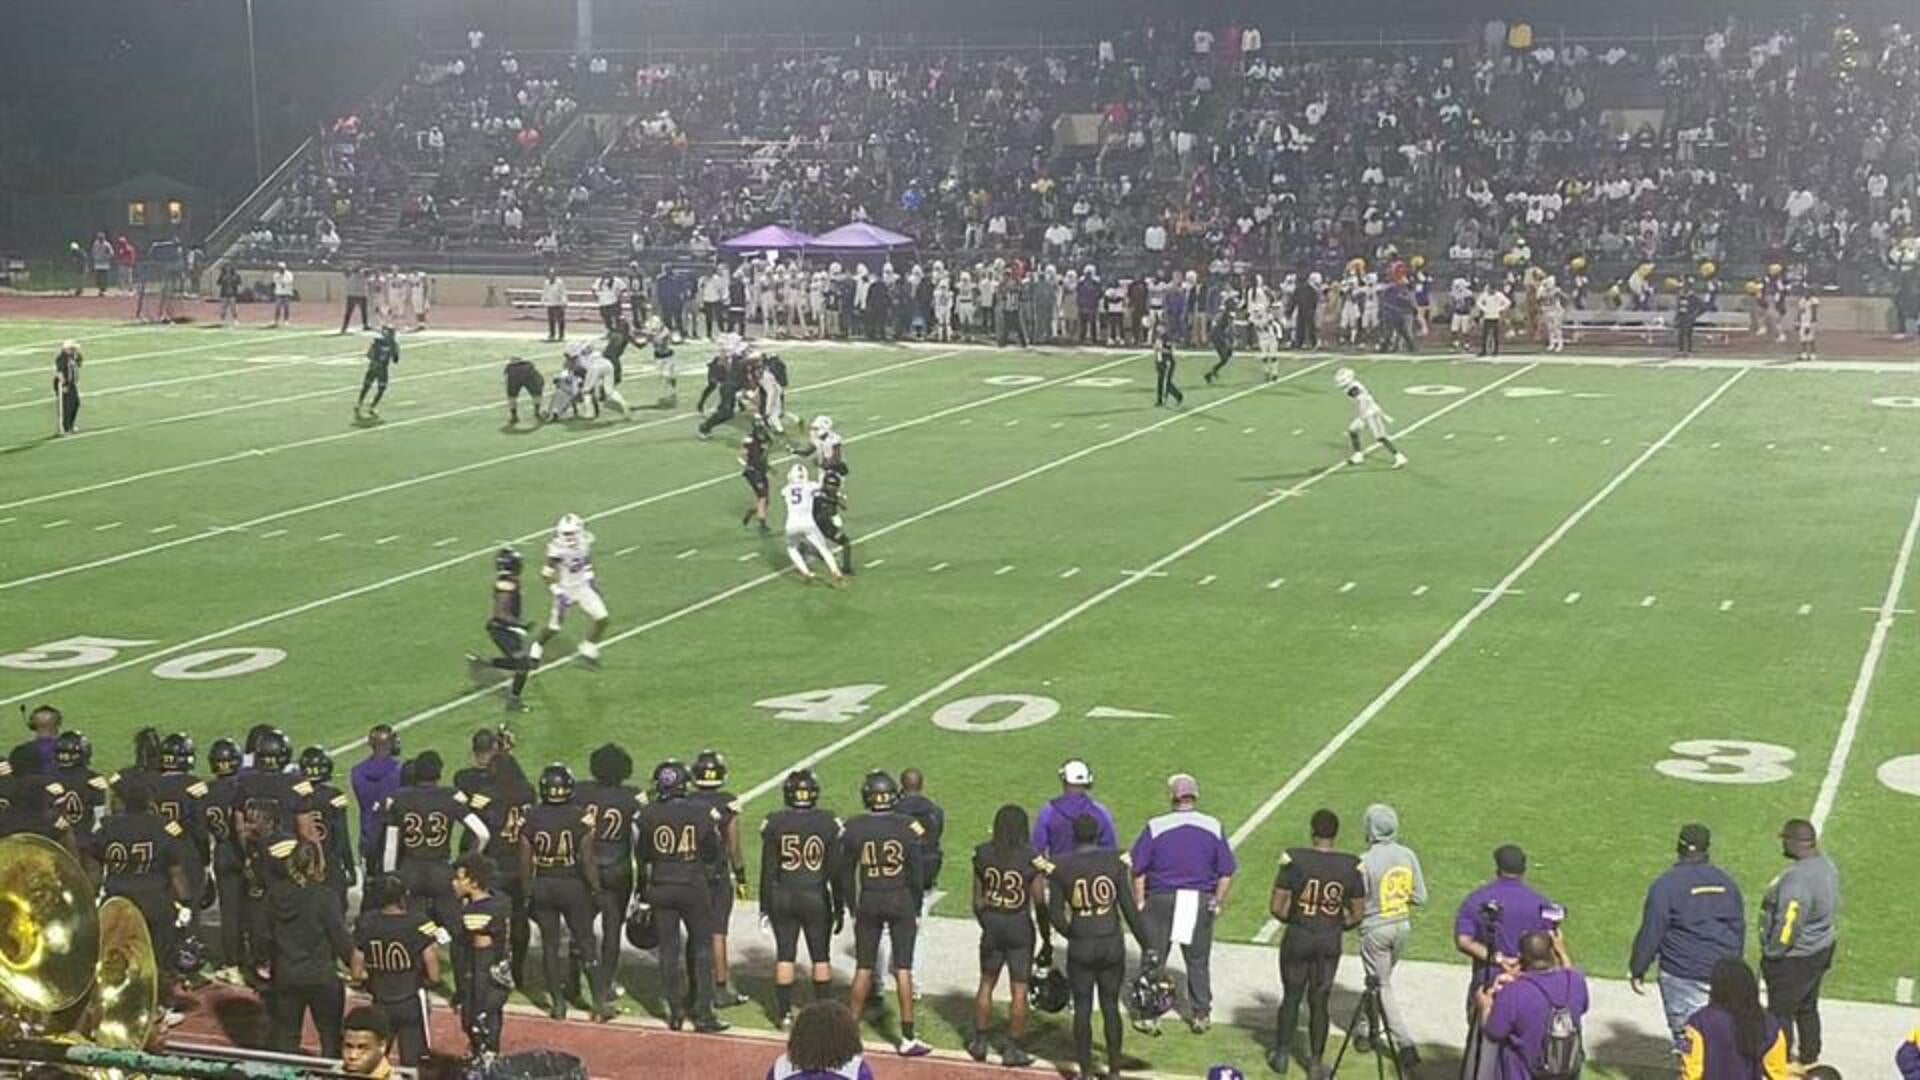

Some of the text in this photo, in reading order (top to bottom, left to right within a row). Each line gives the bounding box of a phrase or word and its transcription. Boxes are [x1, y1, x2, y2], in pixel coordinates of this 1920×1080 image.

[791, 488, 802, 505] 5
[403, 812, 448, 847] 33
[653, 825, 697, 861] 94
[533, 830, 575, 866] 24
[780, 835, 825, 871] 50
[984, 867, 1025, 909] 23
[1297, 879, 1344, 917] 48
